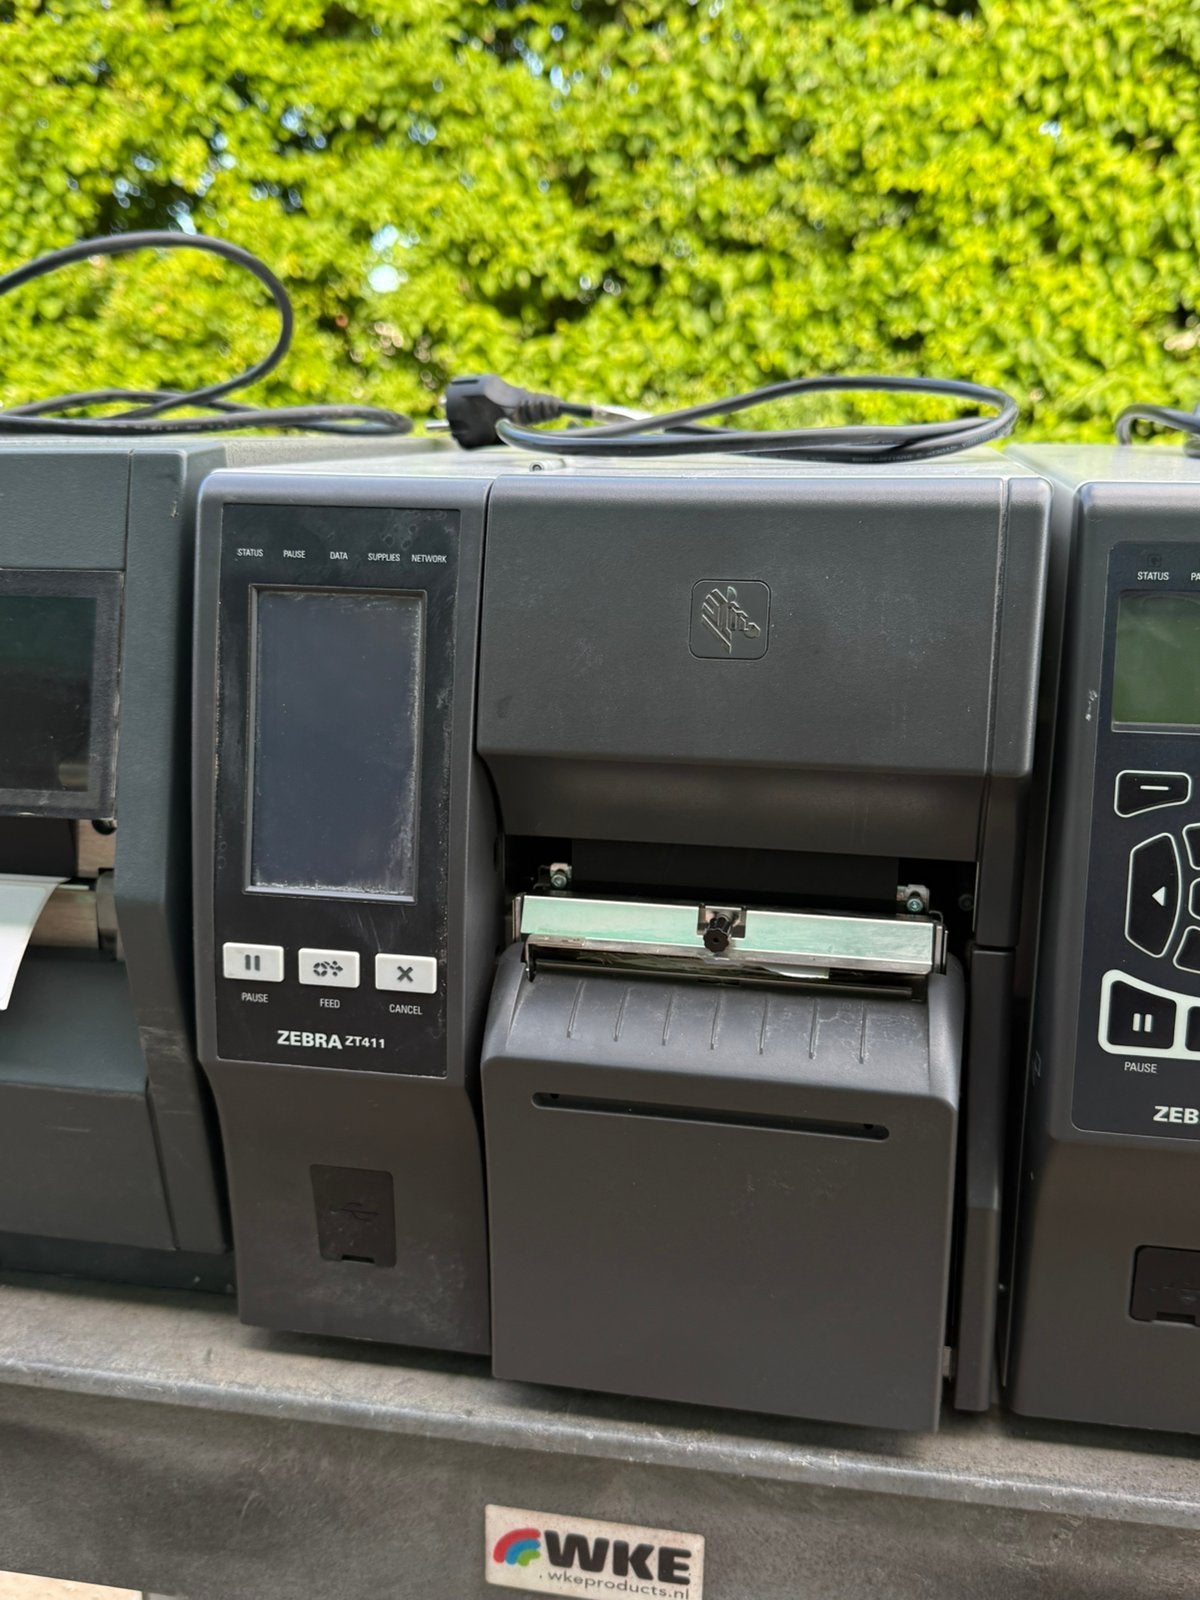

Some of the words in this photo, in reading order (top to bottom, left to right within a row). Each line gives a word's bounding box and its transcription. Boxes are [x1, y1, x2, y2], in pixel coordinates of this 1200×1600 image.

[237, 548, 264, 557] STATUS
[283, 549, 306, 559] PAUSE
[330, 551, 349, 560] DATA
[367, 552, 401, 562] SUPPLIES
[411, 554, 447, 563] NETWORK
[1137, 571, 1170, 581] STATUS
[241, 992, 269, 1003] PAUSE
[319, 998, 340, 1009] FEED
[389, 1003, 422, 1015] CANCEL
[277, 1030, 343, 1049] ZEBRA
[345, 1035, 385, 1049] ZT411
[1124, 1061, 1158, 1074] PAUSE
[1152, 1105, 1200, 1125] ZEB
[544, 1529, 692, 1586] WKE
